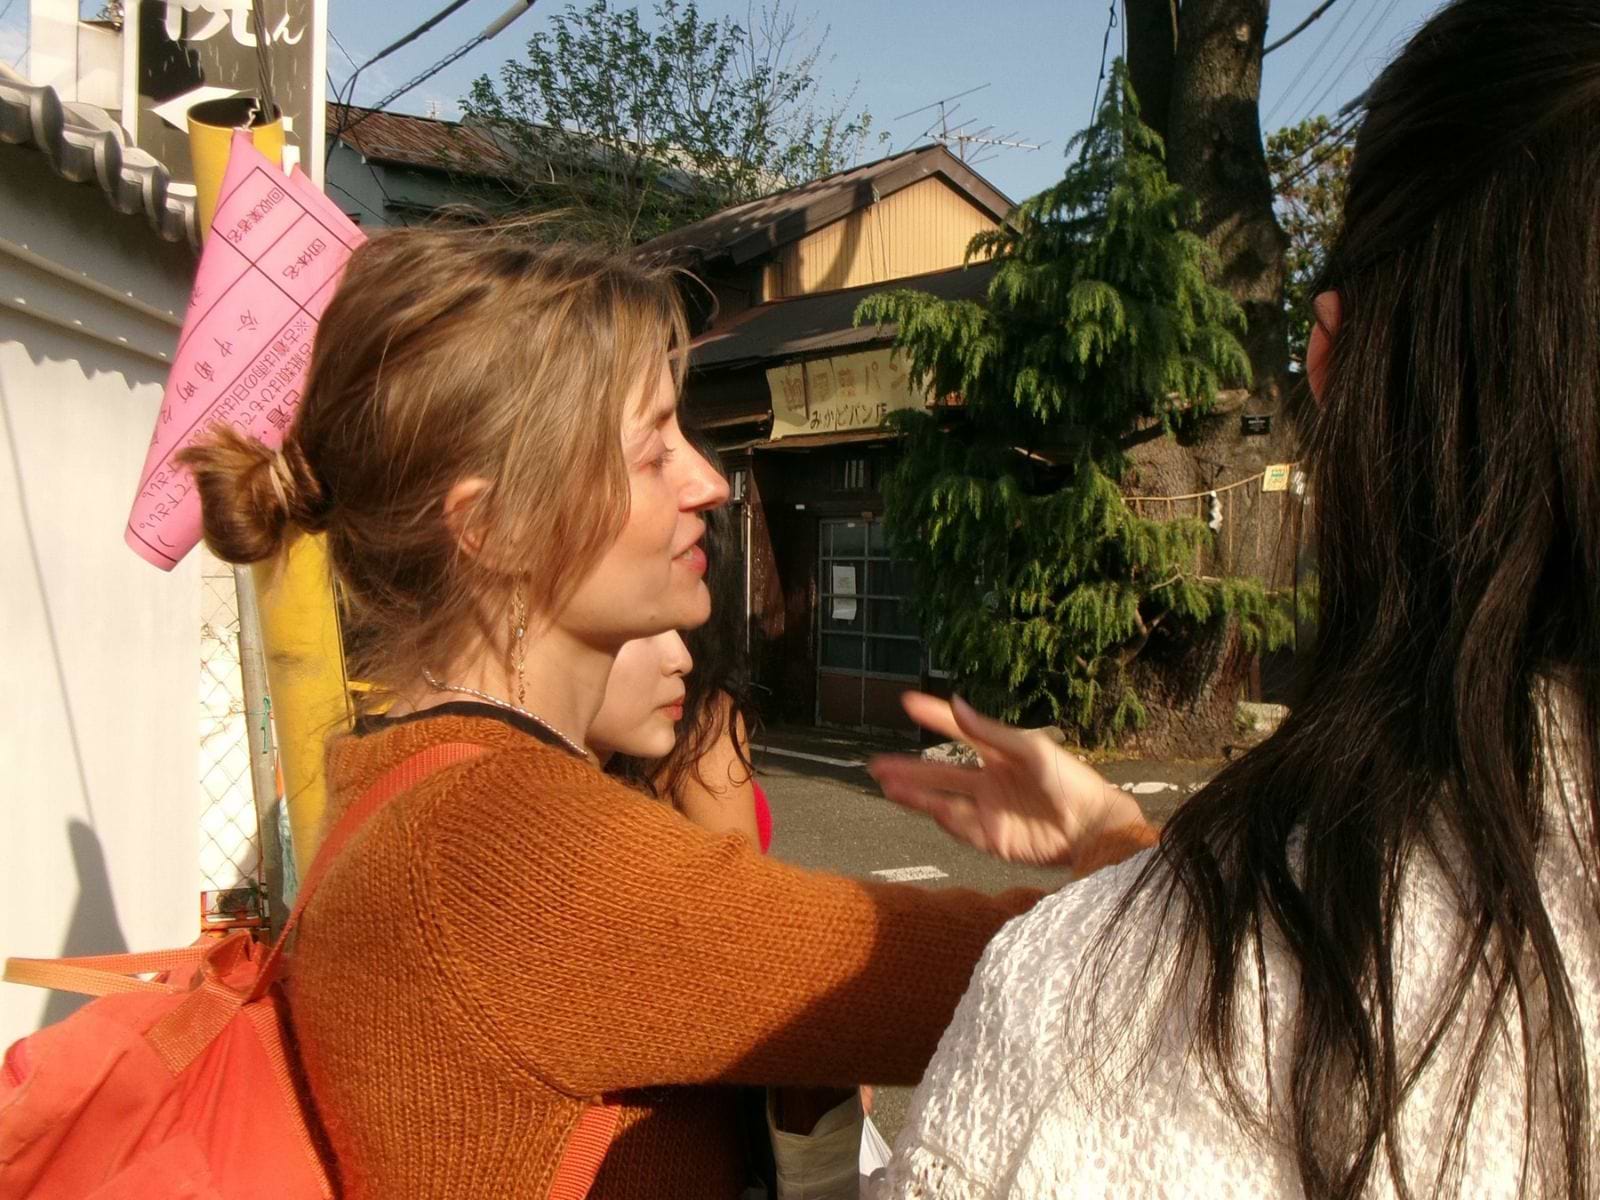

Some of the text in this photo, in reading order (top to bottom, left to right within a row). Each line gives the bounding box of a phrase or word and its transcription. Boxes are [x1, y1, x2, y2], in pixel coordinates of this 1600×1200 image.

[227, 186, 285, 243] 回収業者名
[282, 237, 327, 279] 団体名
